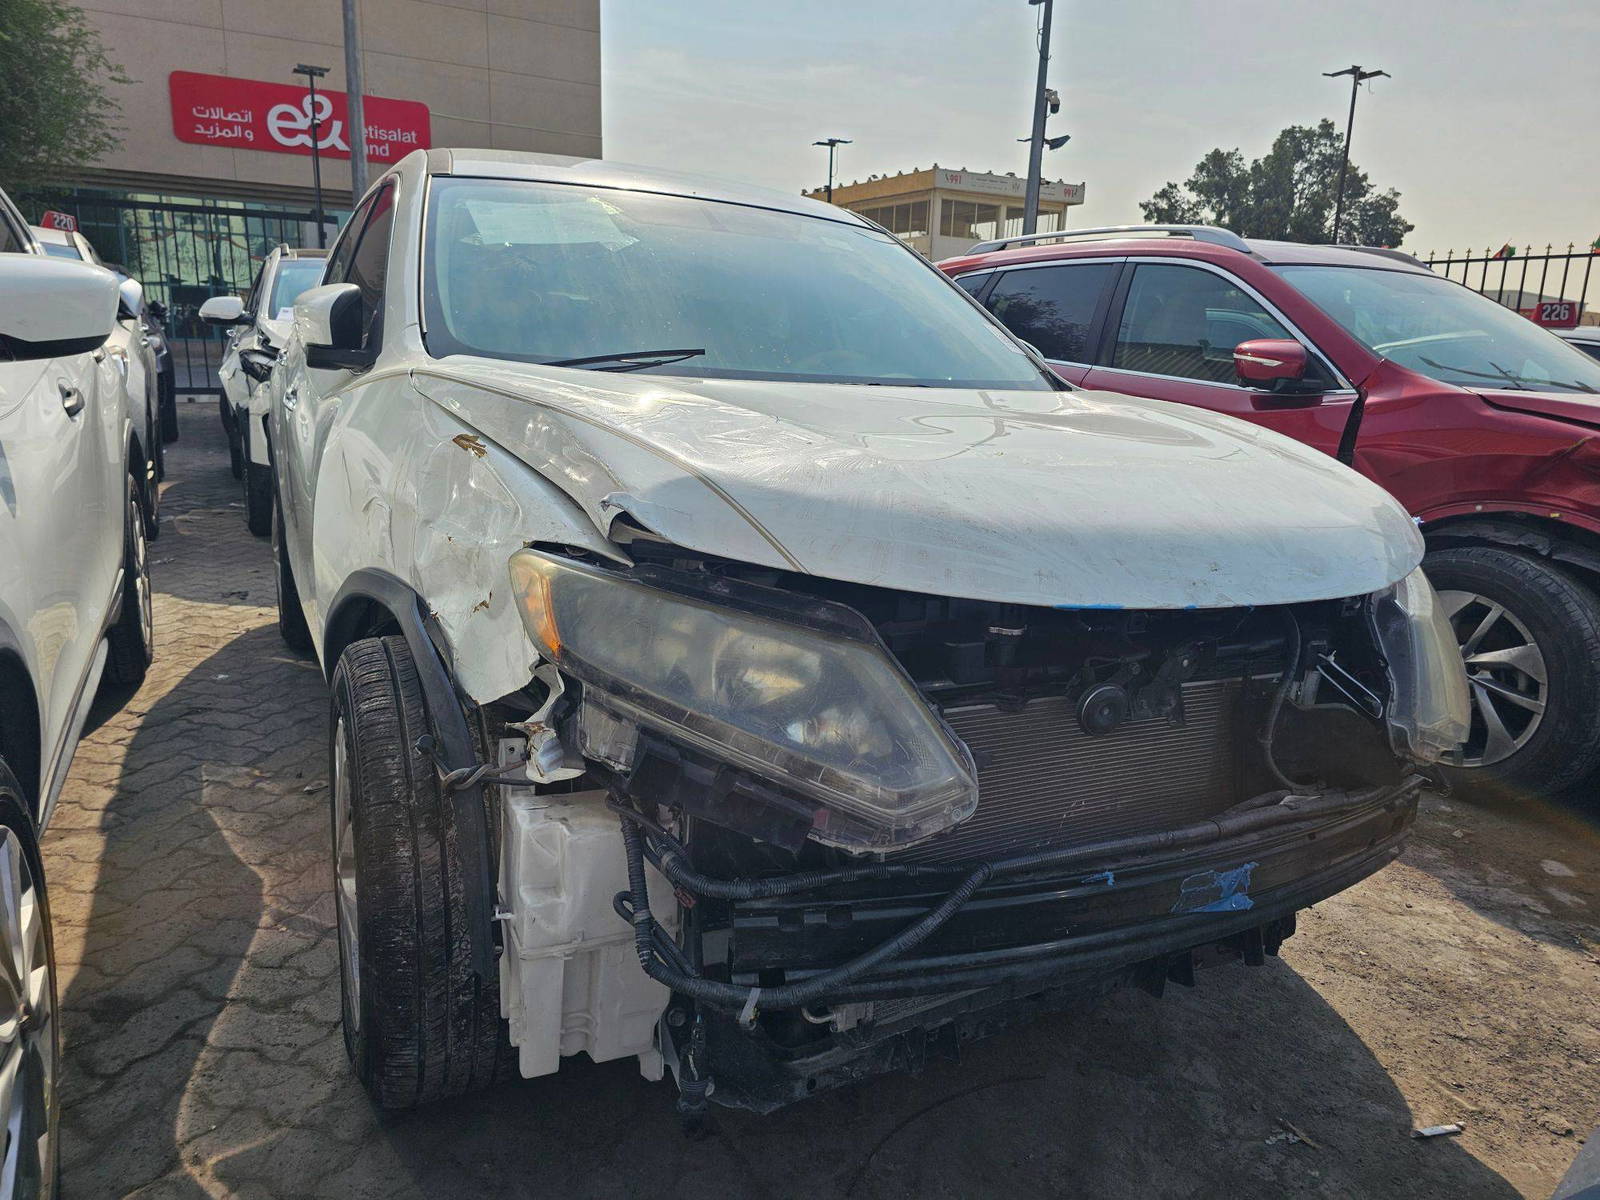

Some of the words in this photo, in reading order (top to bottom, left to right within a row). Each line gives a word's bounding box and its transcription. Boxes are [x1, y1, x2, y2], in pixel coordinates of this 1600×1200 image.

[192, 105, 252, 123] اتصالات
[53, 214, 74, 231] 220
[1541, 304, 1570, 321] 226
